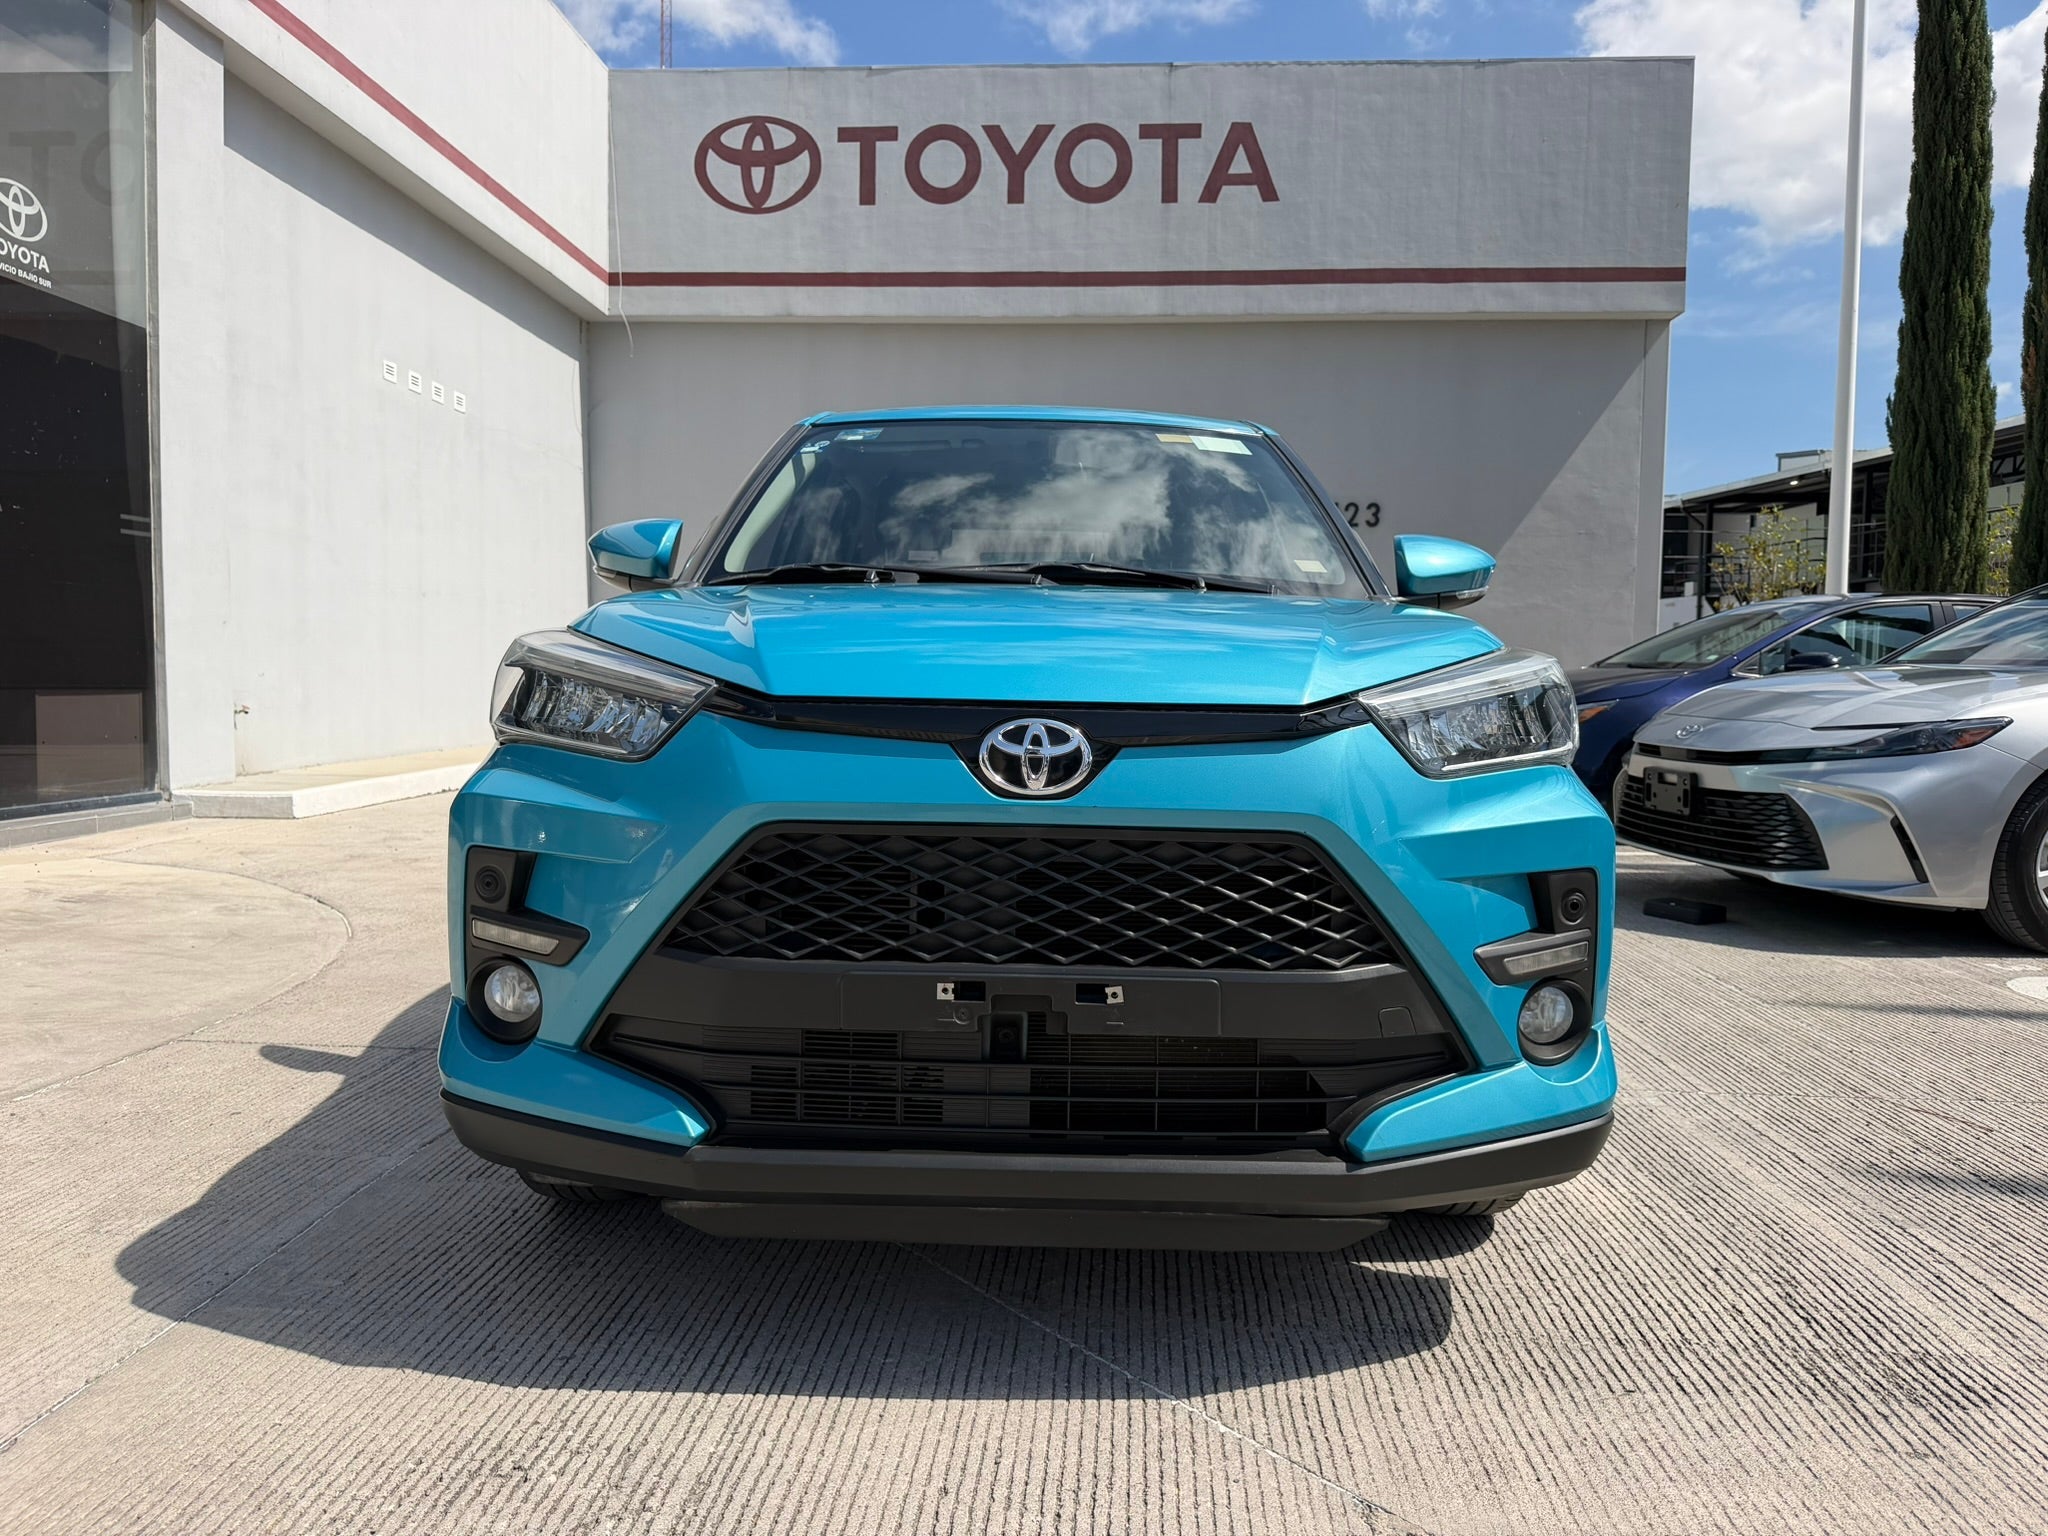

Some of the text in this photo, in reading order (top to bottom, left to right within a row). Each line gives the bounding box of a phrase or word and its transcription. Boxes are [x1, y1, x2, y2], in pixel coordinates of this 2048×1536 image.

[837, 121, 1280, 206] TOYOTA
[38, 276, 52, 289] SUR
[1334, 502, 1381, 528] 23
